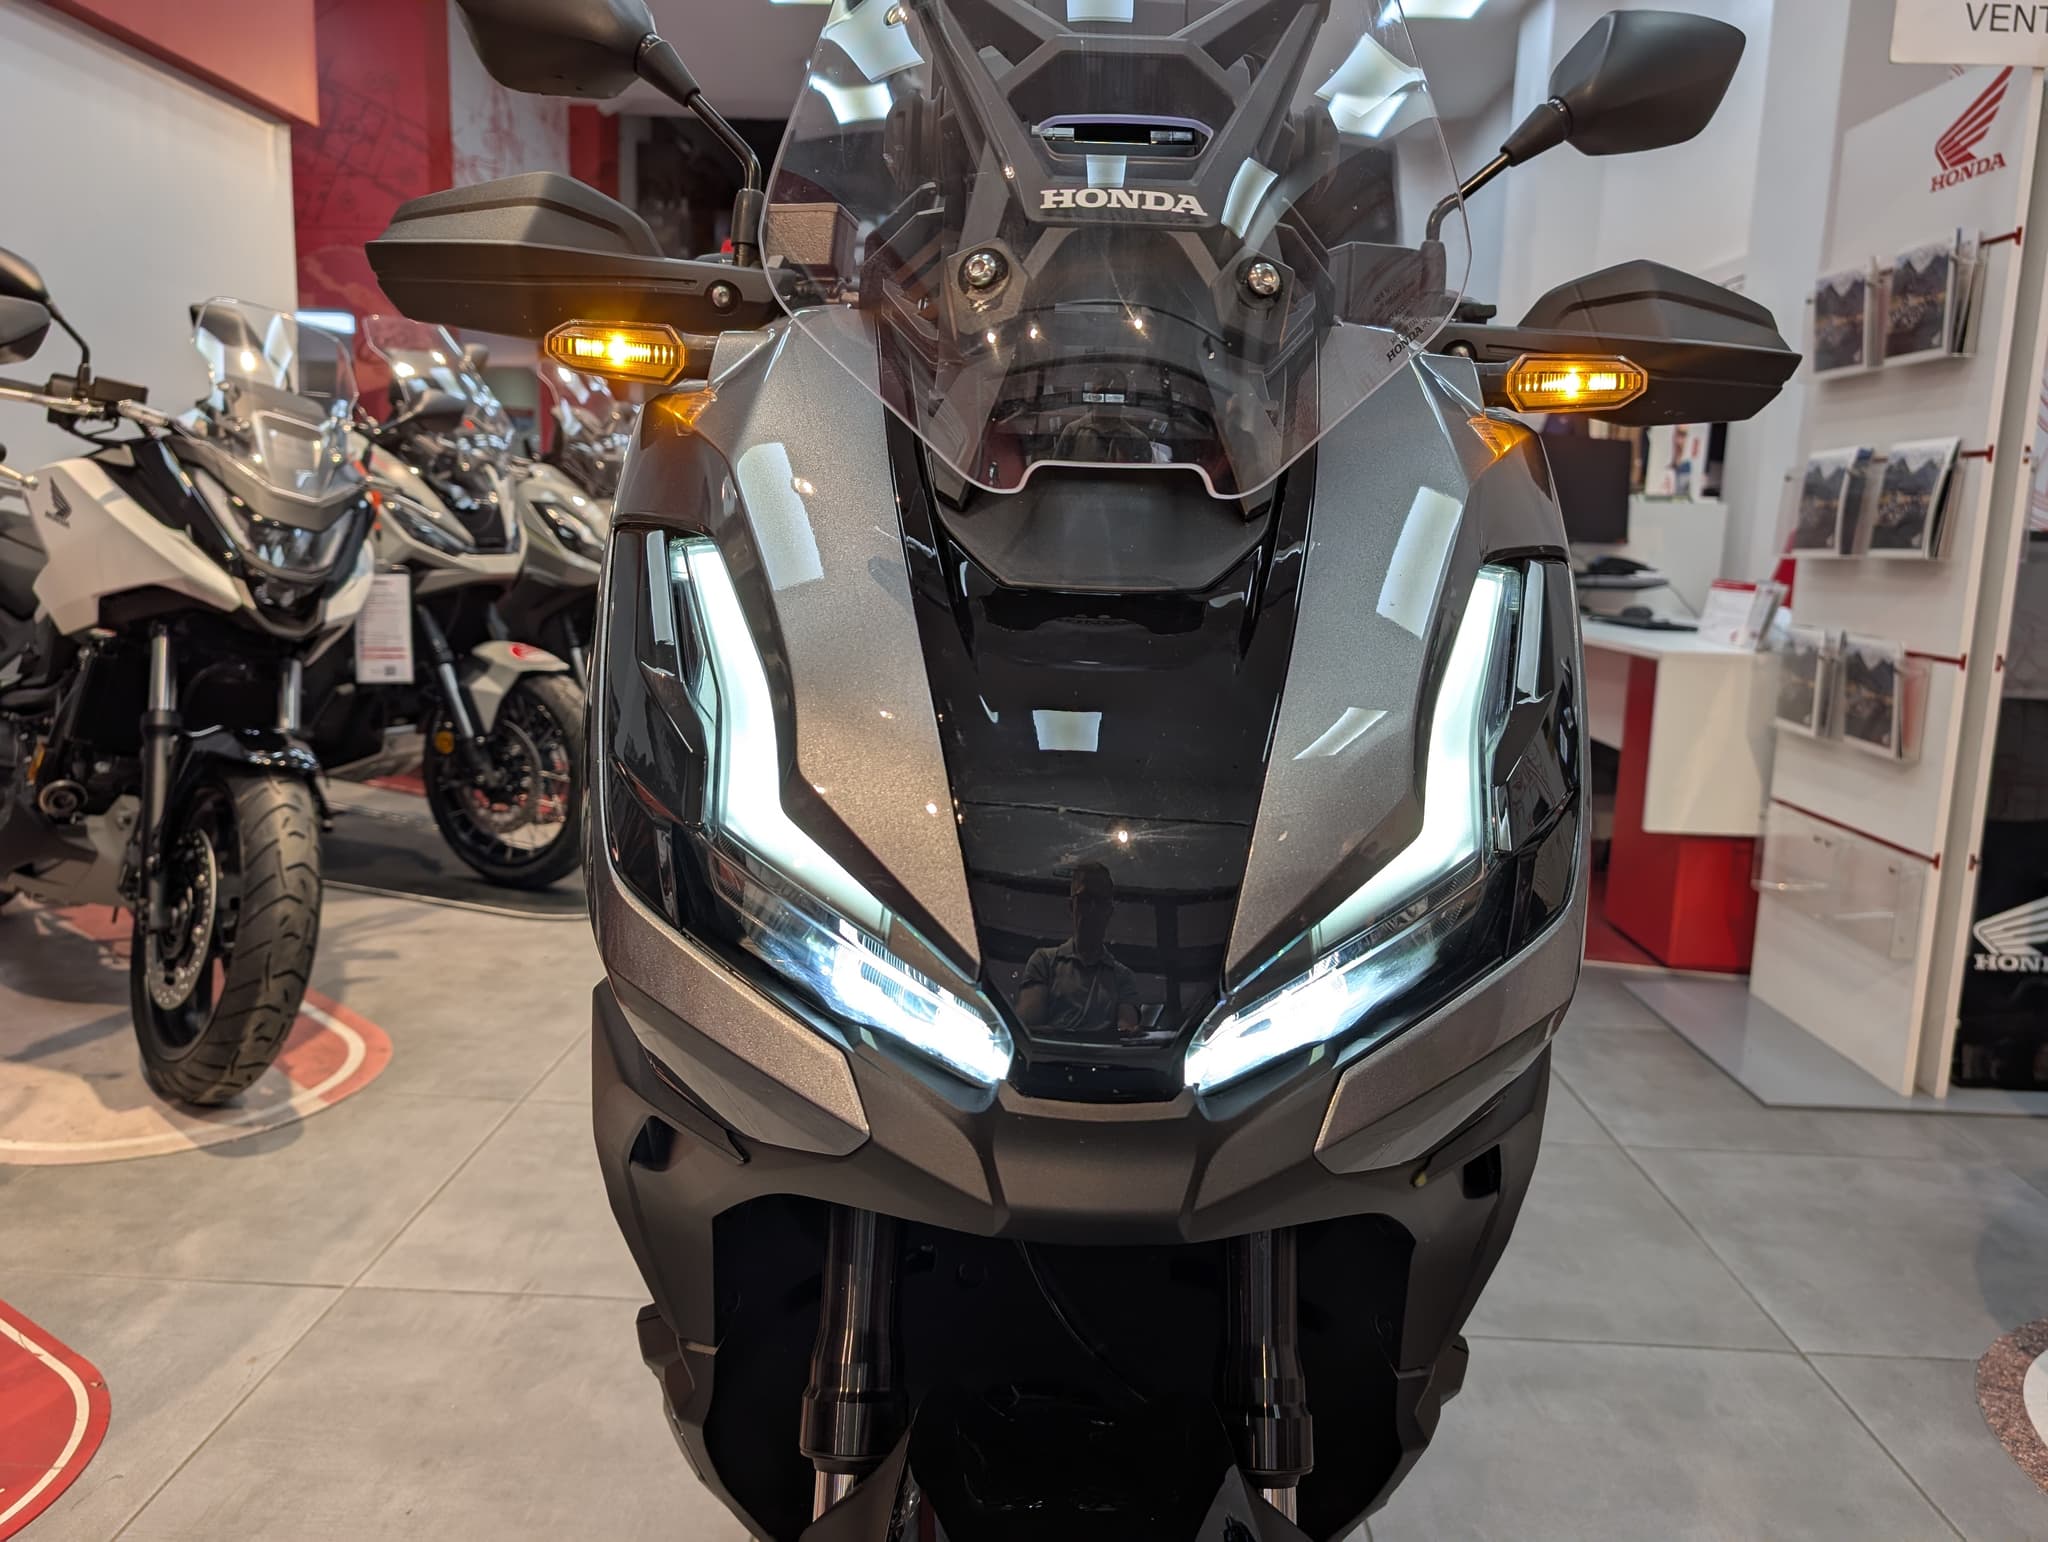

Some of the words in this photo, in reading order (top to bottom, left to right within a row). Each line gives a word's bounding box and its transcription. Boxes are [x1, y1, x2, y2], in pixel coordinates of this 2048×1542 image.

[1930, 152, 2006, 192] HONDA
[1040, 188, 1208, 217] HONDA
[1385, 326, 1424, 362] HONDA
